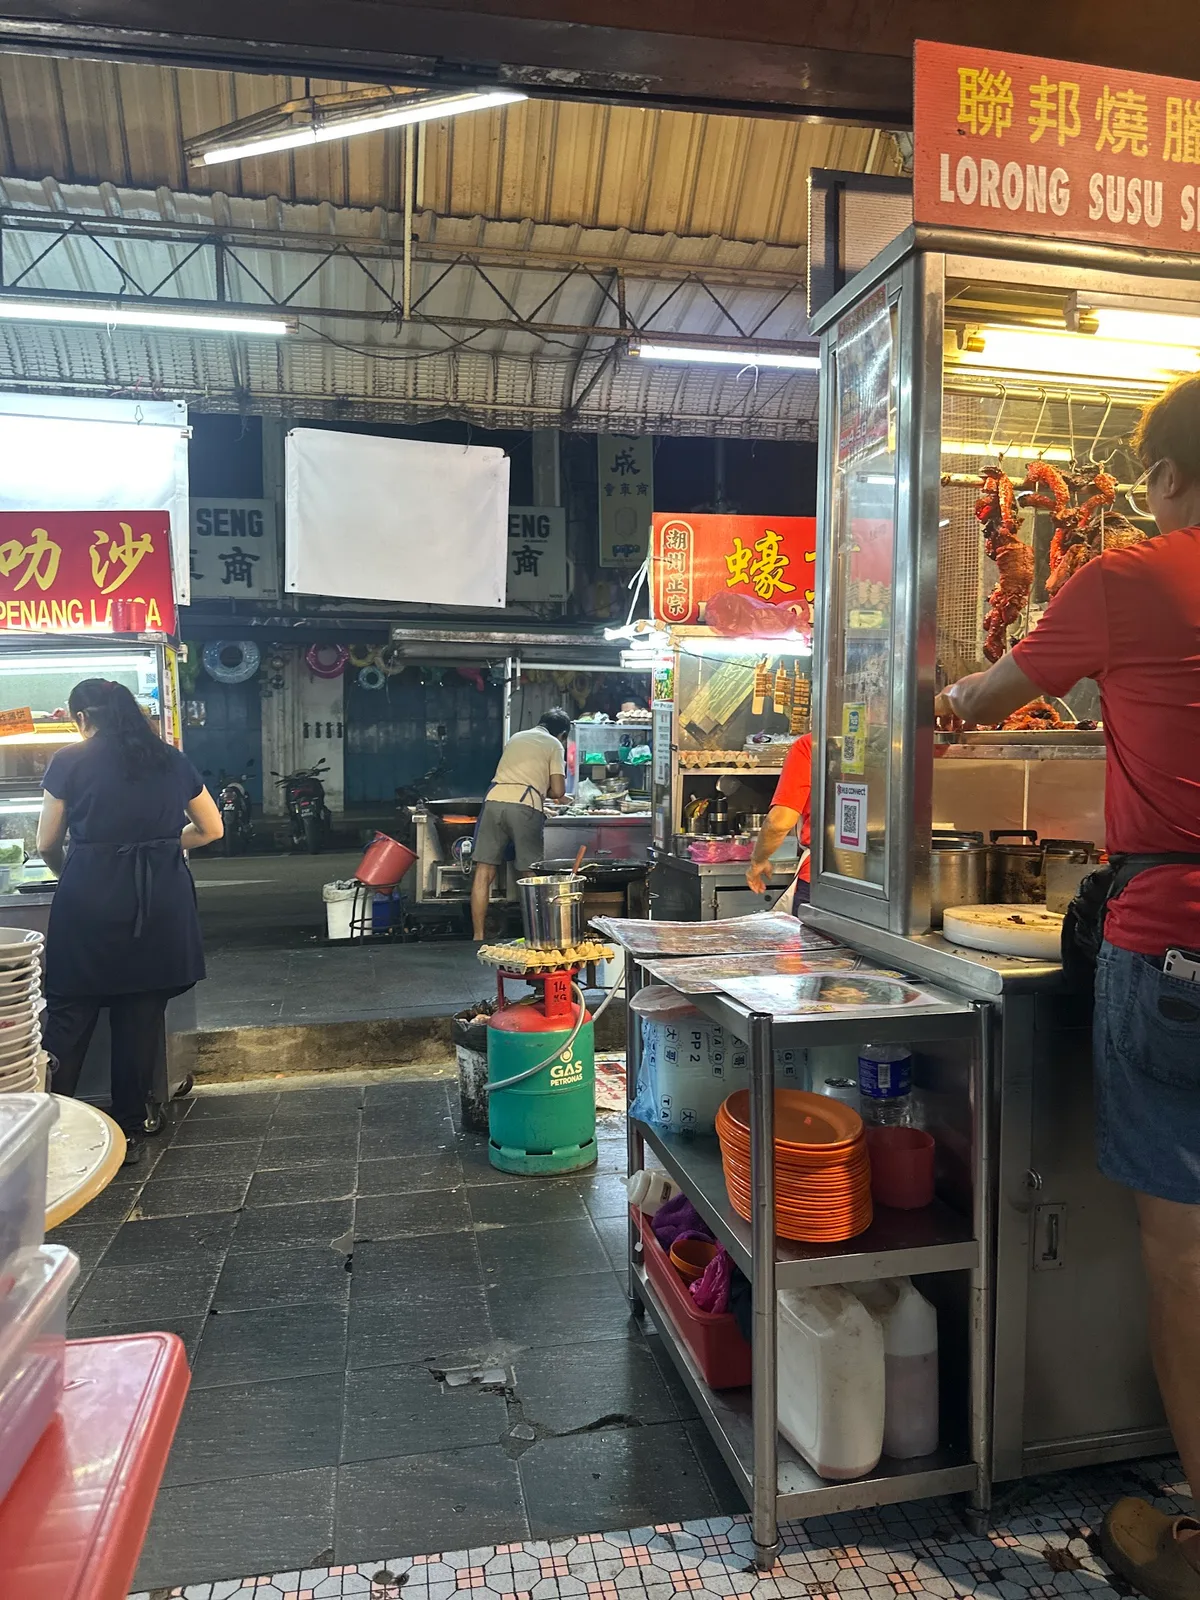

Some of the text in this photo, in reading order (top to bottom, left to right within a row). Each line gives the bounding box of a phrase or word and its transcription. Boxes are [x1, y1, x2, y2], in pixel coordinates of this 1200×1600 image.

[939, 153, 1070, 217] LORONG
[1088, 172, 1163, 228] SUSU
[196, 508, 264, 538] SENG
[508, 514, 550, 538] ENG
[512, 545, 544, 577] 商
[666, 529, 688, 616] 潮州正宗
[724, 529, 816, 602] 蠔
[90, 597, 162, 628] LAA
[553, 981, 566, 993] 14
[689, 1031, 701, 1063] PP 2
[550, 1061, 583, 1079] GAS
[550, 1073, 583, 1087] PETRONAS
